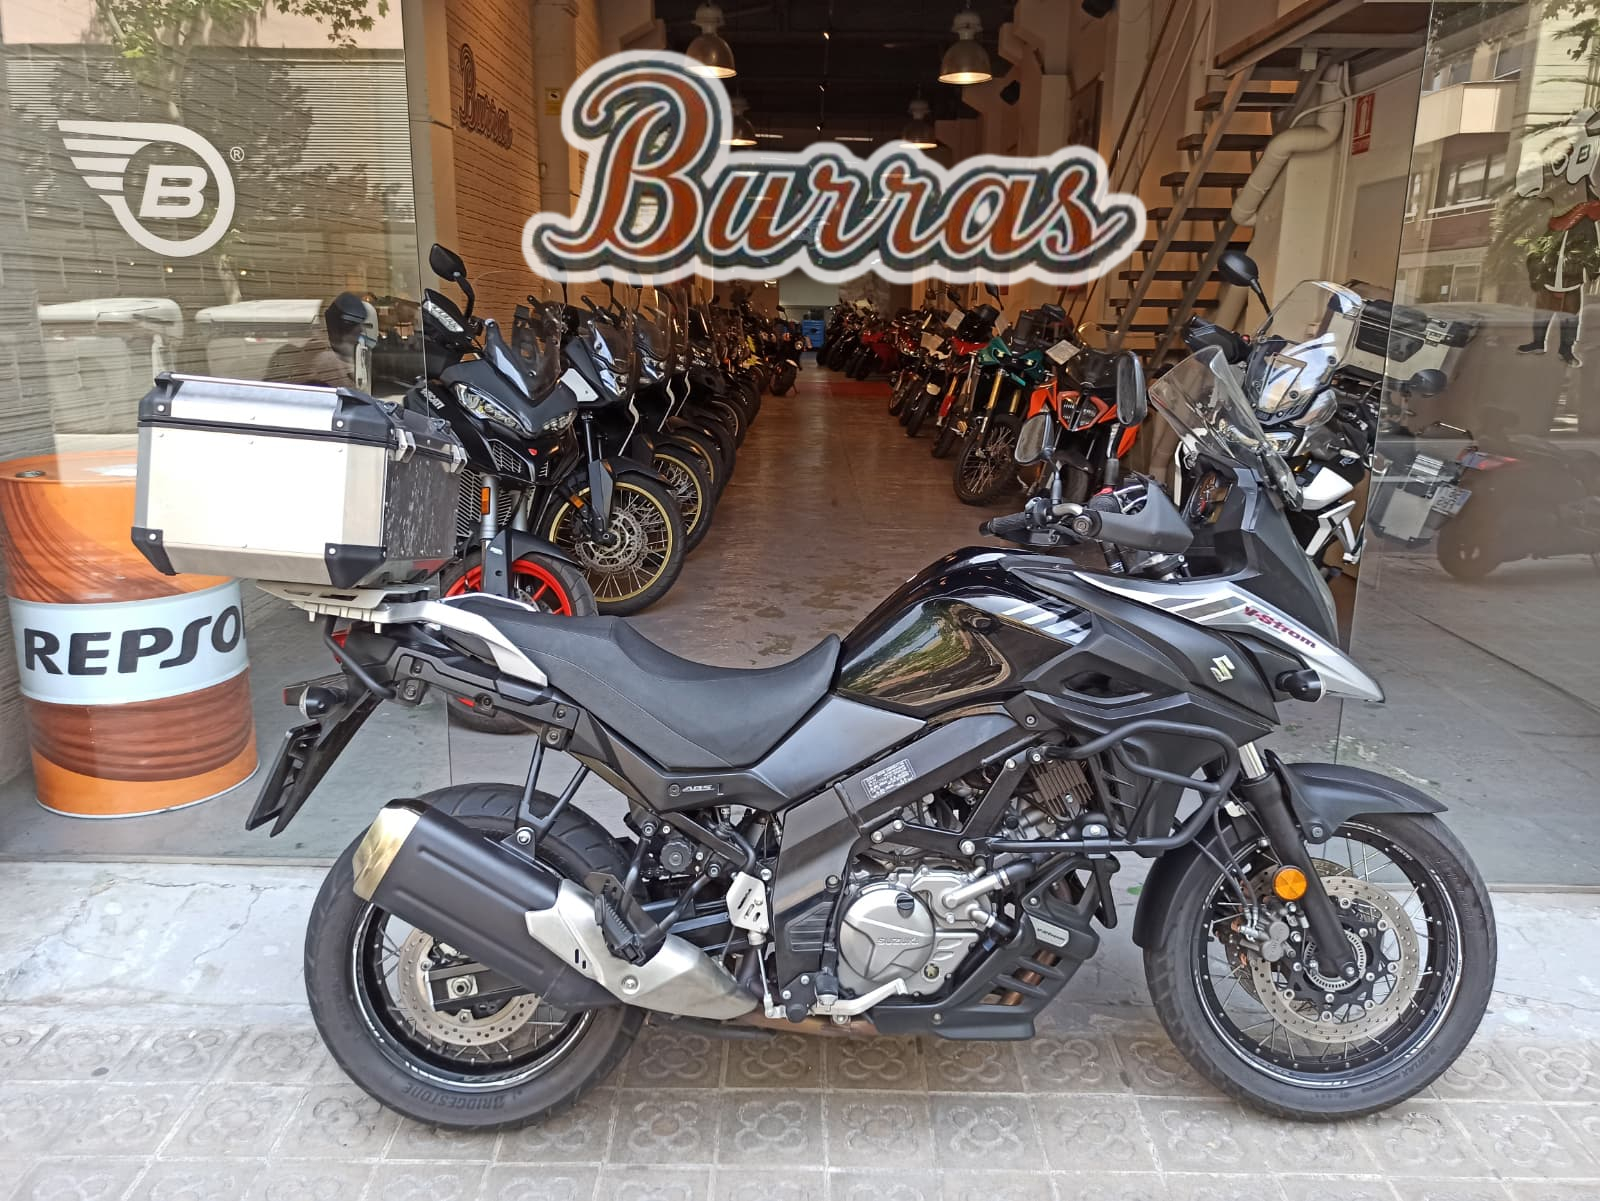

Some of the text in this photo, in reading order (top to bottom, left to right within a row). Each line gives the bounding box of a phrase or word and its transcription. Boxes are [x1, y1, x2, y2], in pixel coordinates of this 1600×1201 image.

[139, 165, 208, 219] B
[528, 56, 1140, 275] Burras
[23, 604, 246, 676] REPSO
